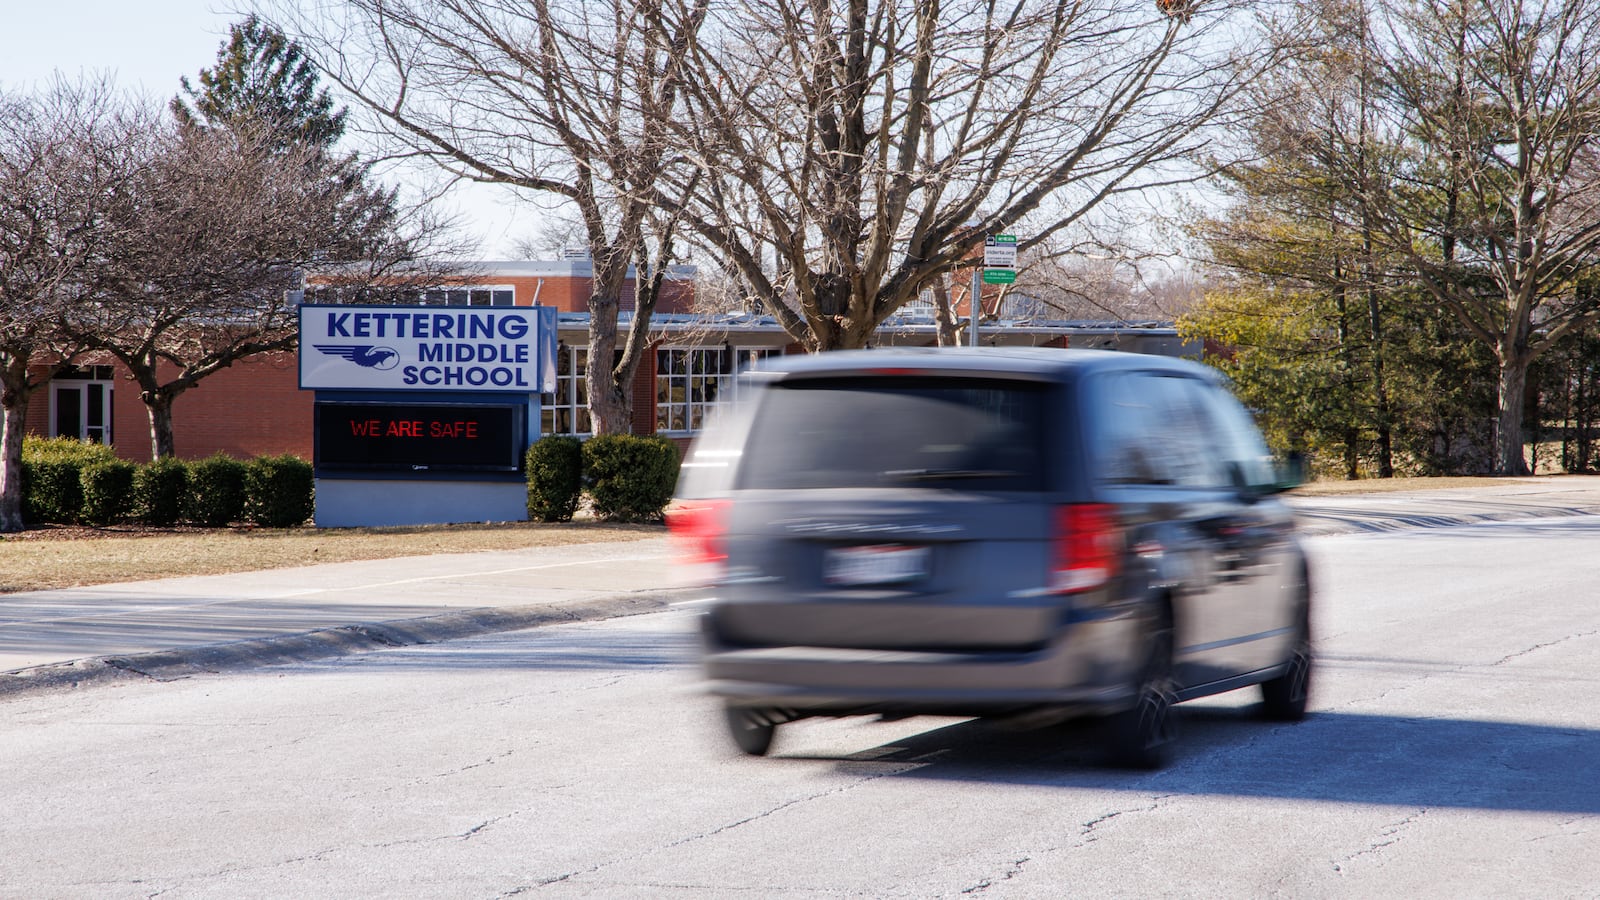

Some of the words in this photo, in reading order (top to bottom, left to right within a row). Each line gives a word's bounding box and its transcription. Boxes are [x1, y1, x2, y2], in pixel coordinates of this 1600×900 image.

[327, 312, 529, 340] KETTERING
[418, 343, 529, 363] MIDDLE
[402, 365, 529, 387] SCHOOL
[351, 420, 381, 437] WE
[386, 421, 424, 437] ARE
[430, 421, 478, 439] SAFE
